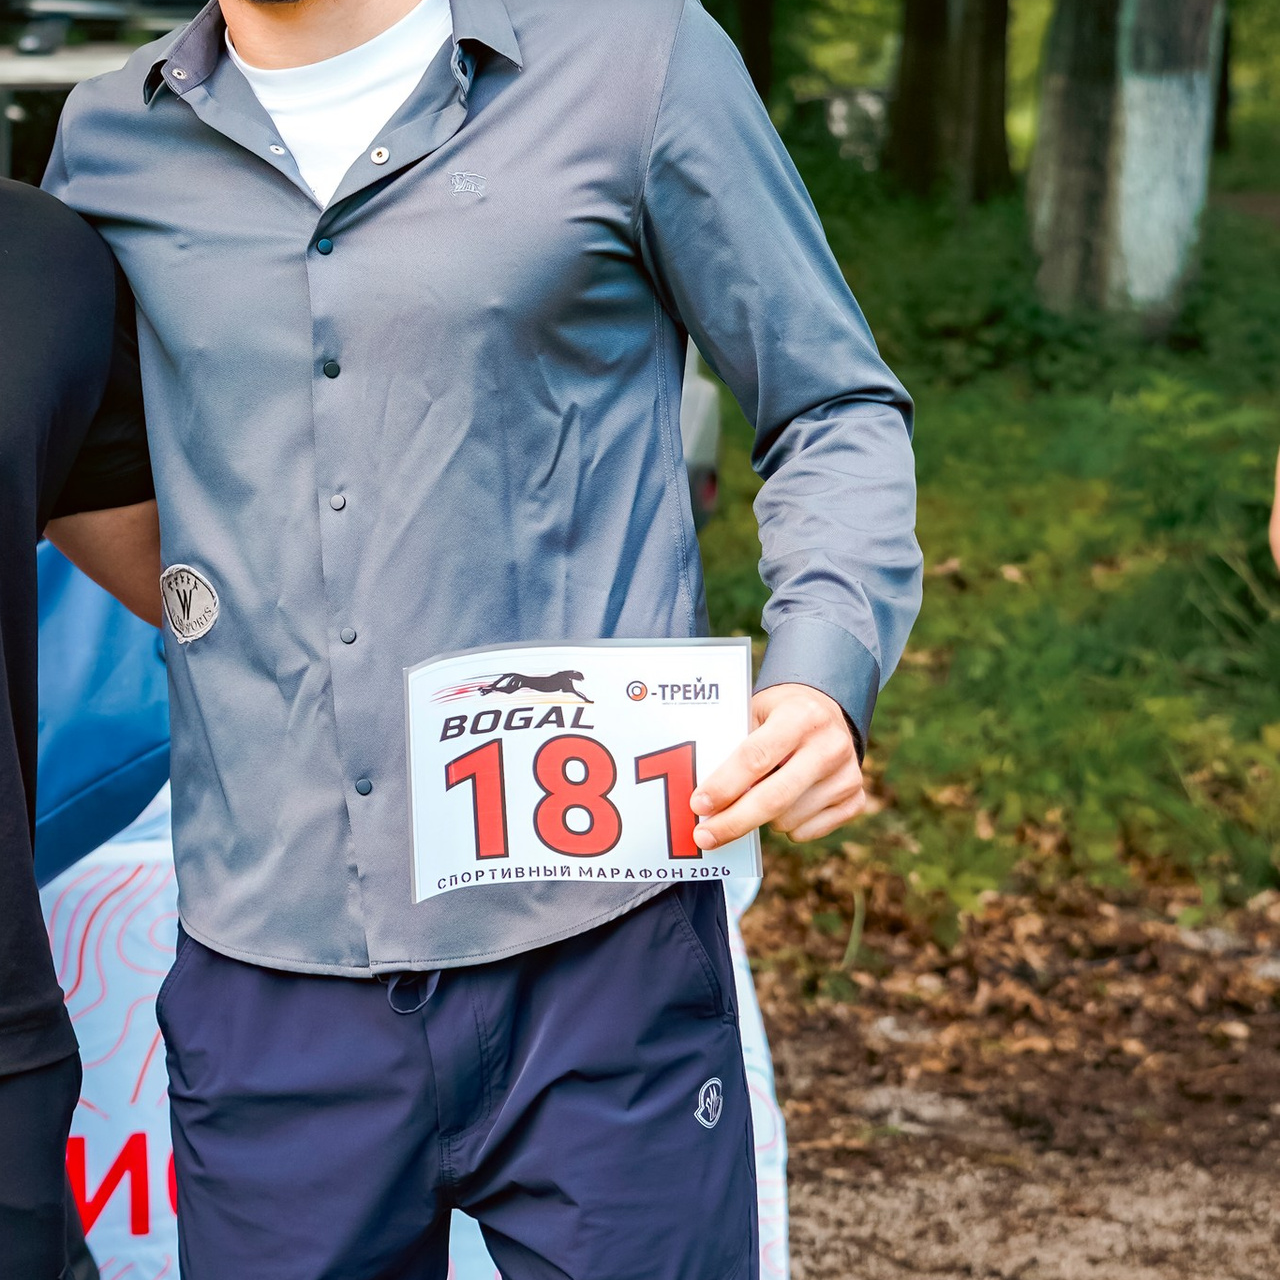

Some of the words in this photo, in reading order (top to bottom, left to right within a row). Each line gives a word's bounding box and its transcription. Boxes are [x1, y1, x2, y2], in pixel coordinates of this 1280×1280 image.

[439, 706, 595, 742] BOGAL
[444, 734, 702, 860] 181
[437, 865, 571, 890] СПОРТИВНЫЙ
[579, 866, 683, 879] МАРАФОН
[690, 866, 731, 879] 2026
